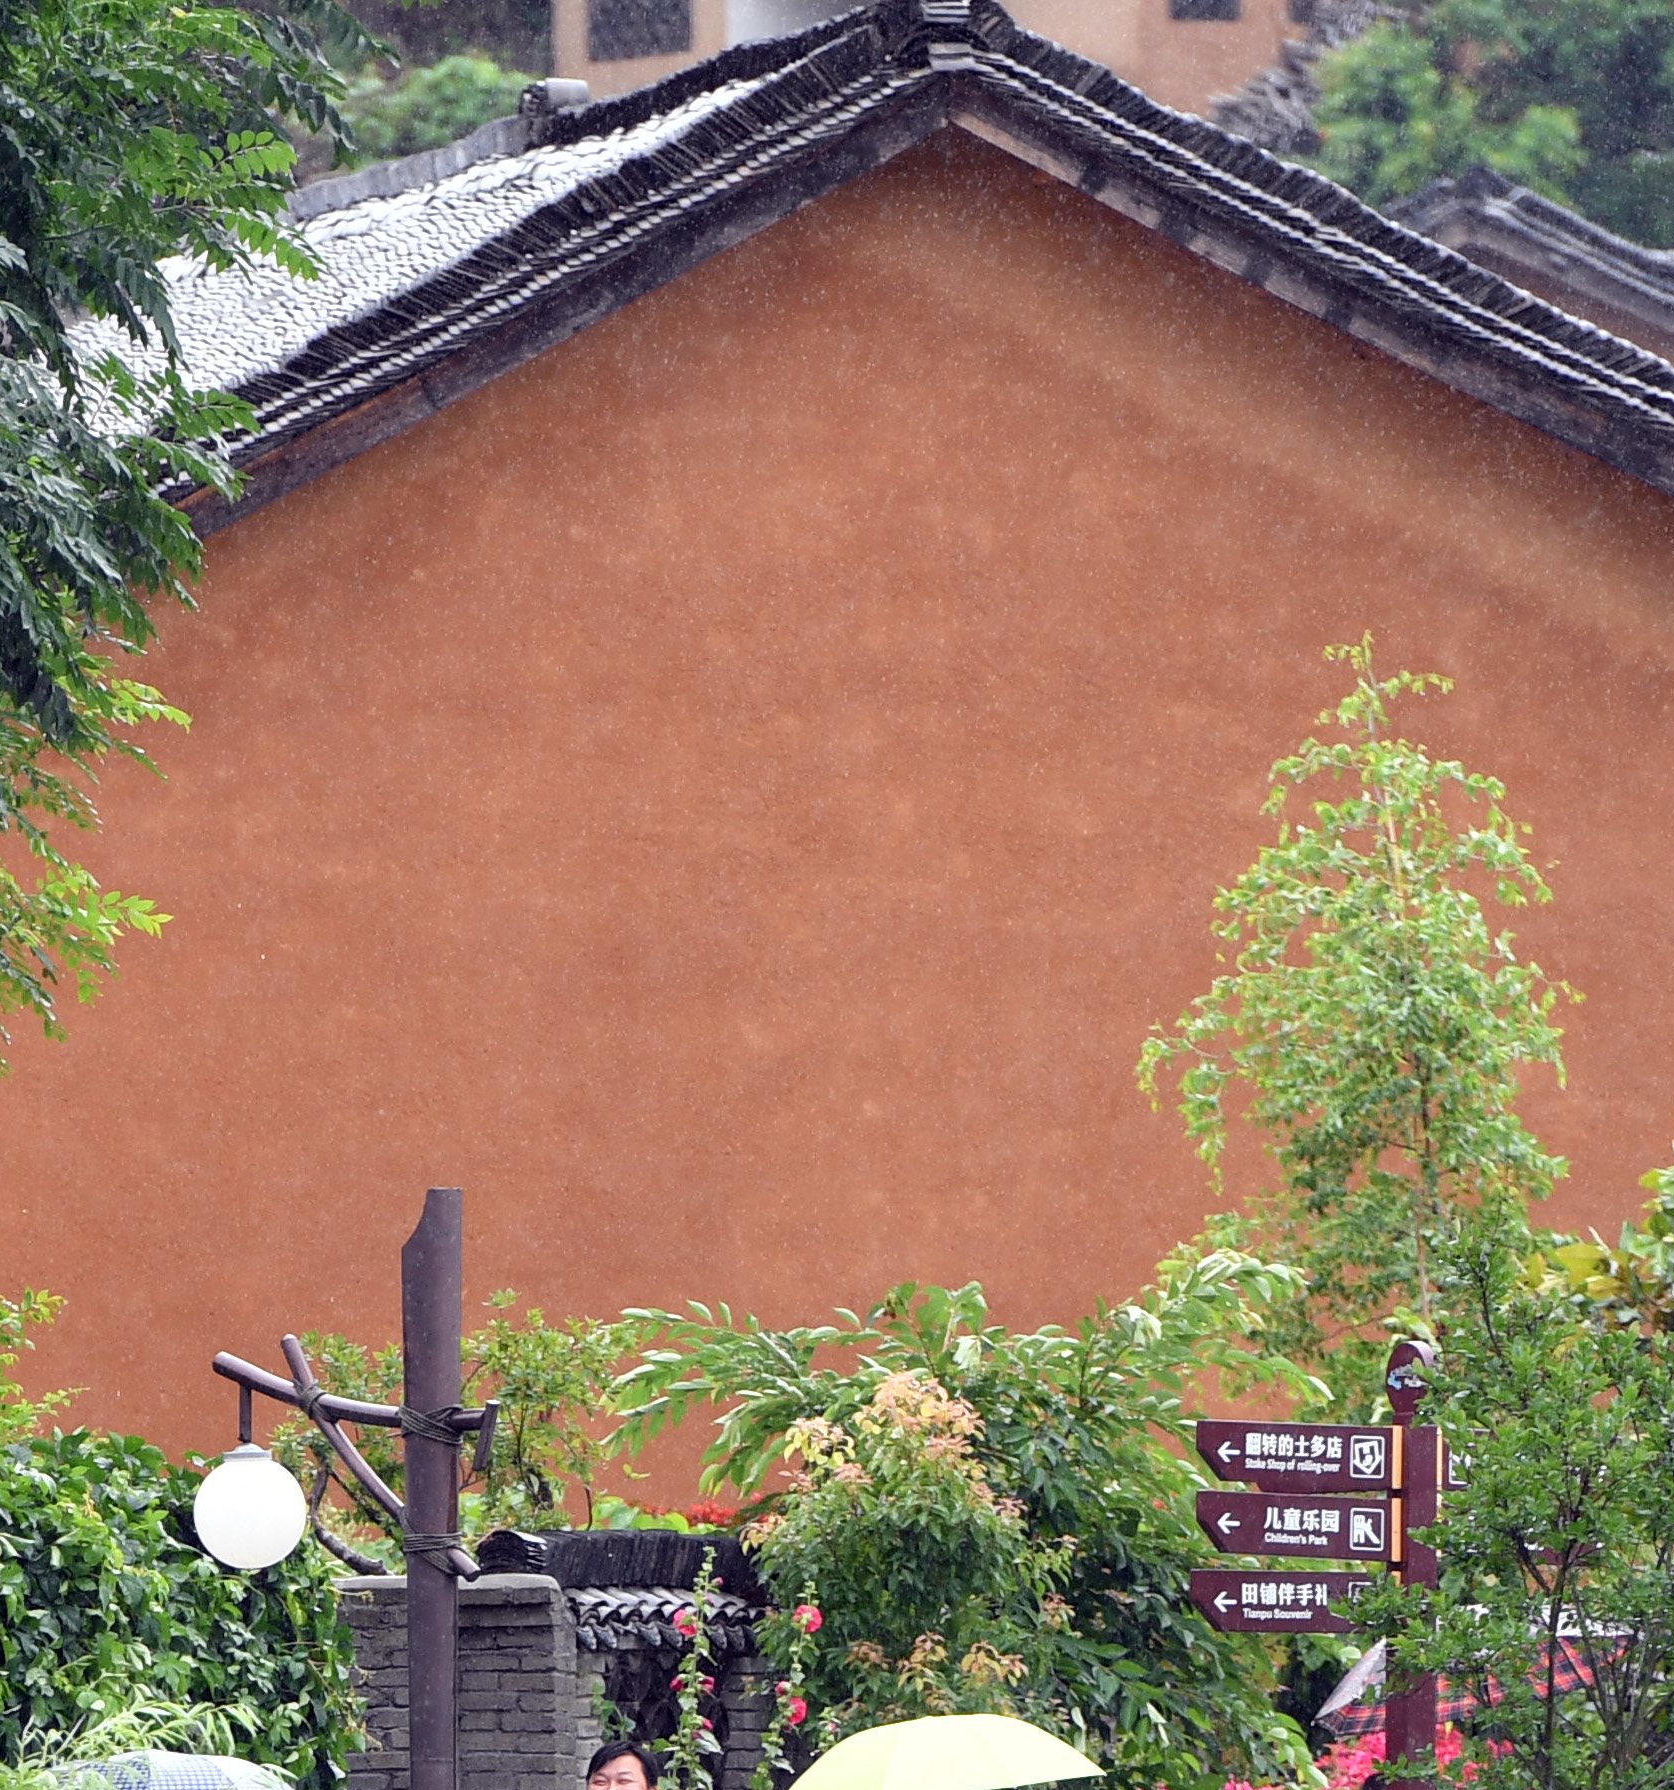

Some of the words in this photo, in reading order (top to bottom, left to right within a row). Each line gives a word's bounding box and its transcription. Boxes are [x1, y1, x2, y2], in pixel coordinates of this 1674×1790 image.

[1245, 1432, 1343, 1458] 翻转的士多店
[1266, 1459, 1286, 1472] Shop
[1287, 1460, 1296, 1470] of
[1297, 1460, 1341, 1474] rolling-over
[1263, 1506, 1340, 1533] 儿童乐园
[1264, 1532, 1307, 1544] Children's
[1308, 1534, 1328, 1545] Park
[1241, 1582, 1328, 1606] 田铺伴手礼
[1242, 1607, 1273, 1620] Tianpu
[1273, 1608, 1314, 1619] Souvenir
